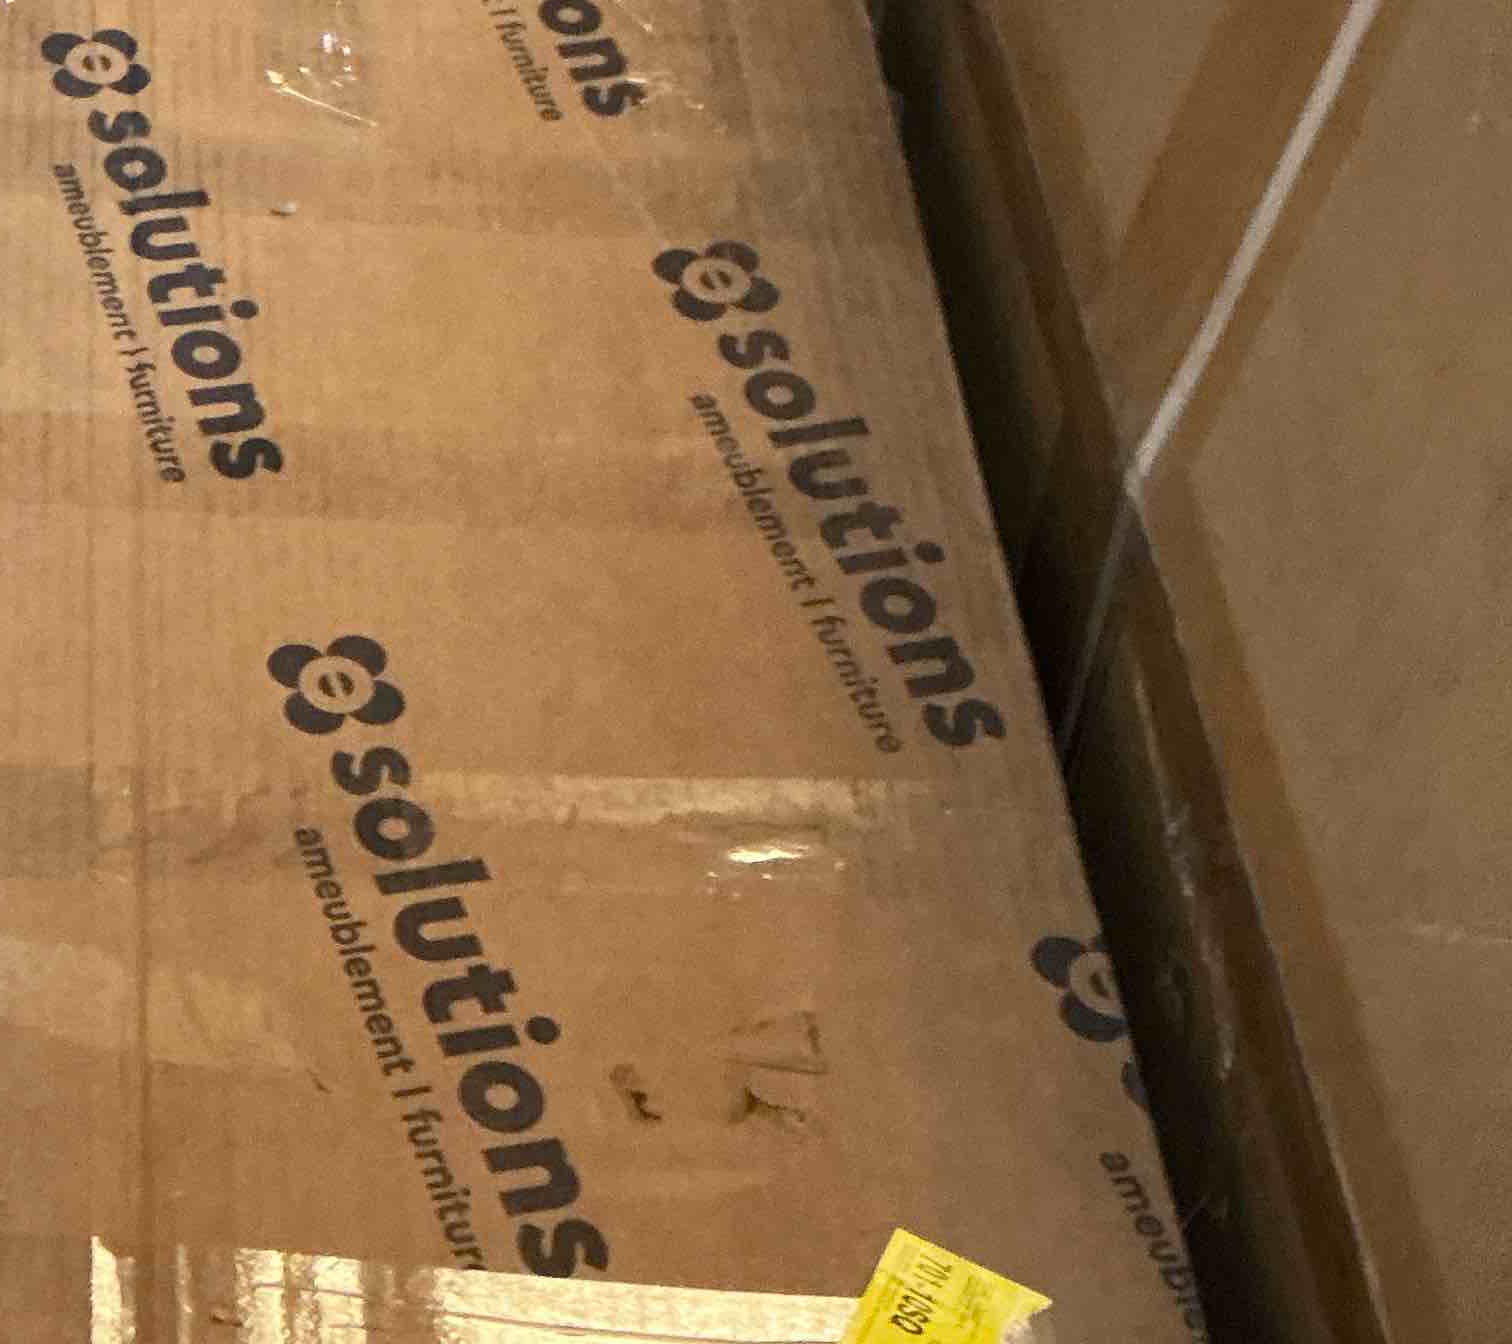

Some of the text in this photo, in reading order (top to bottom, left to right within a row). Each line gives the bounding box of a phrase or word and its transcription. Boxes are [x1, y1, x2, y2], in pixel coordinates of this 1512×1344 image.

[491, 17, 565, 124] furniture
[54, 162, 136, 343] ameublement
[127, 360, 187, 485] furniture
[88, 109, 285, 481] solutions
[688, 391, 816, 594] ameublement
[807, 612, 905, 755] furniture
[717, 329, 1007, 748] solutions
[292, 824, 415, 1077] ameublement
[332, 746, 611, 1280] solutions
